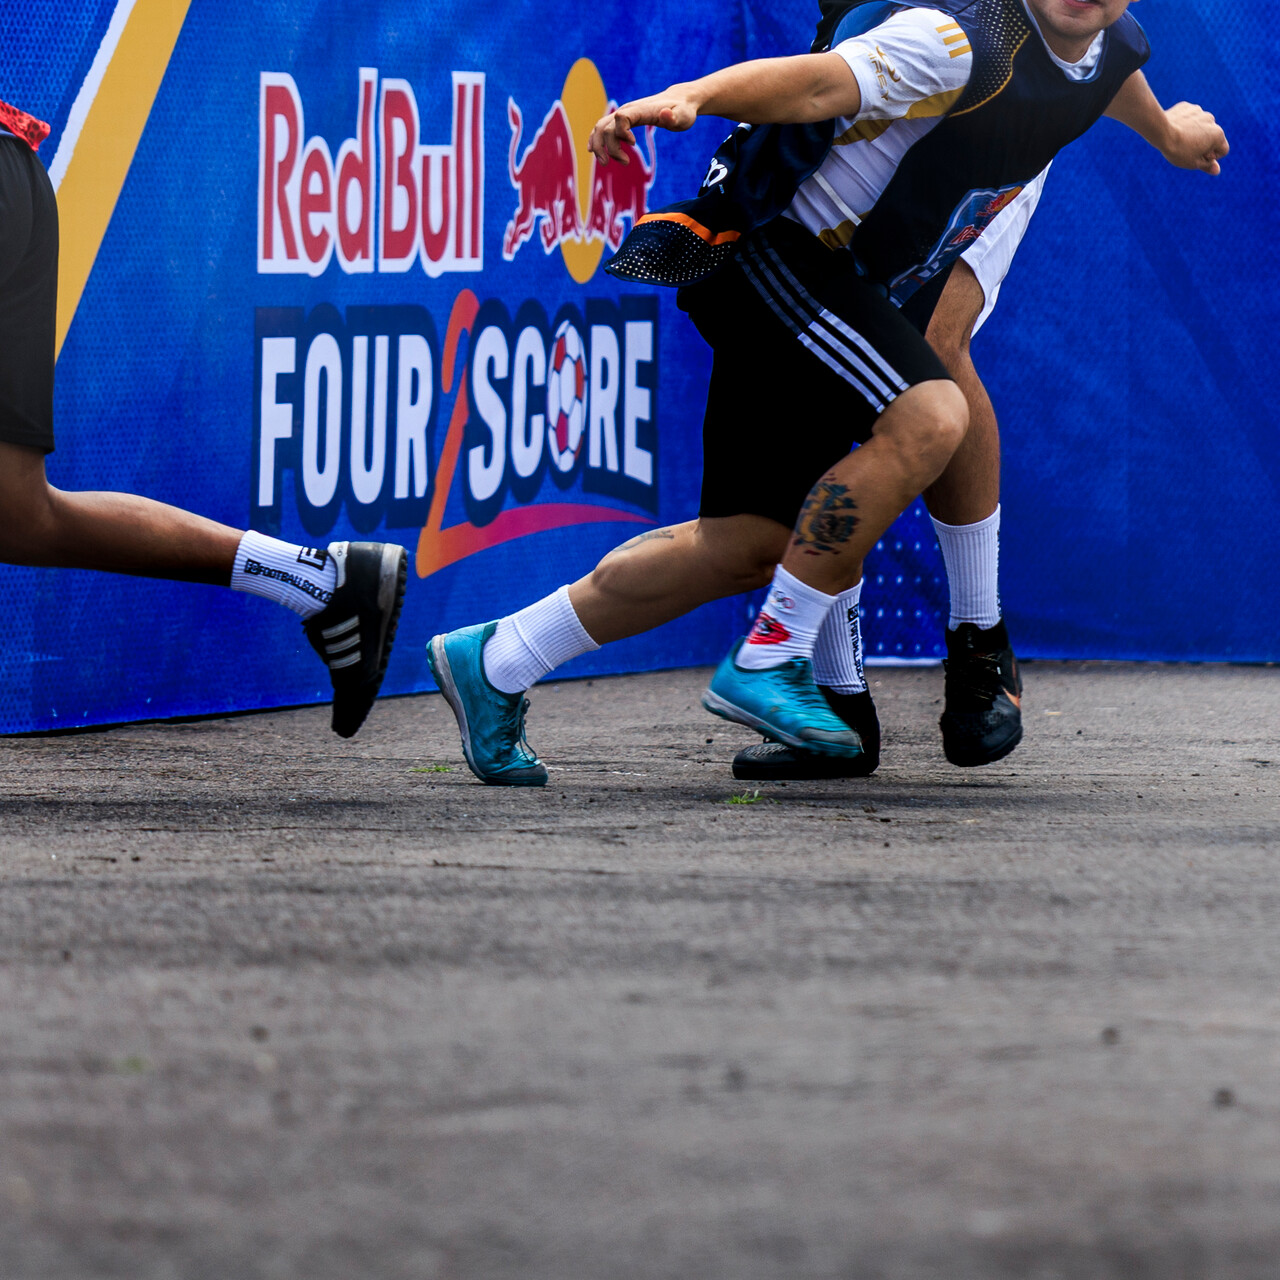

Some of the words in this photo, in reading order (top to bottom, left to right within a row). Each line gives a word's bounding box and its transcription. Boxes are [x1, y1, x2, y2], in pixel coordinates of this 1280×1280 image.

[258, 67, 377, 276] Red
[378, 70, 486, 277] Bull
[258, 333, 433, 508] FOUR
[468, 320, 655, 503] SCORE
